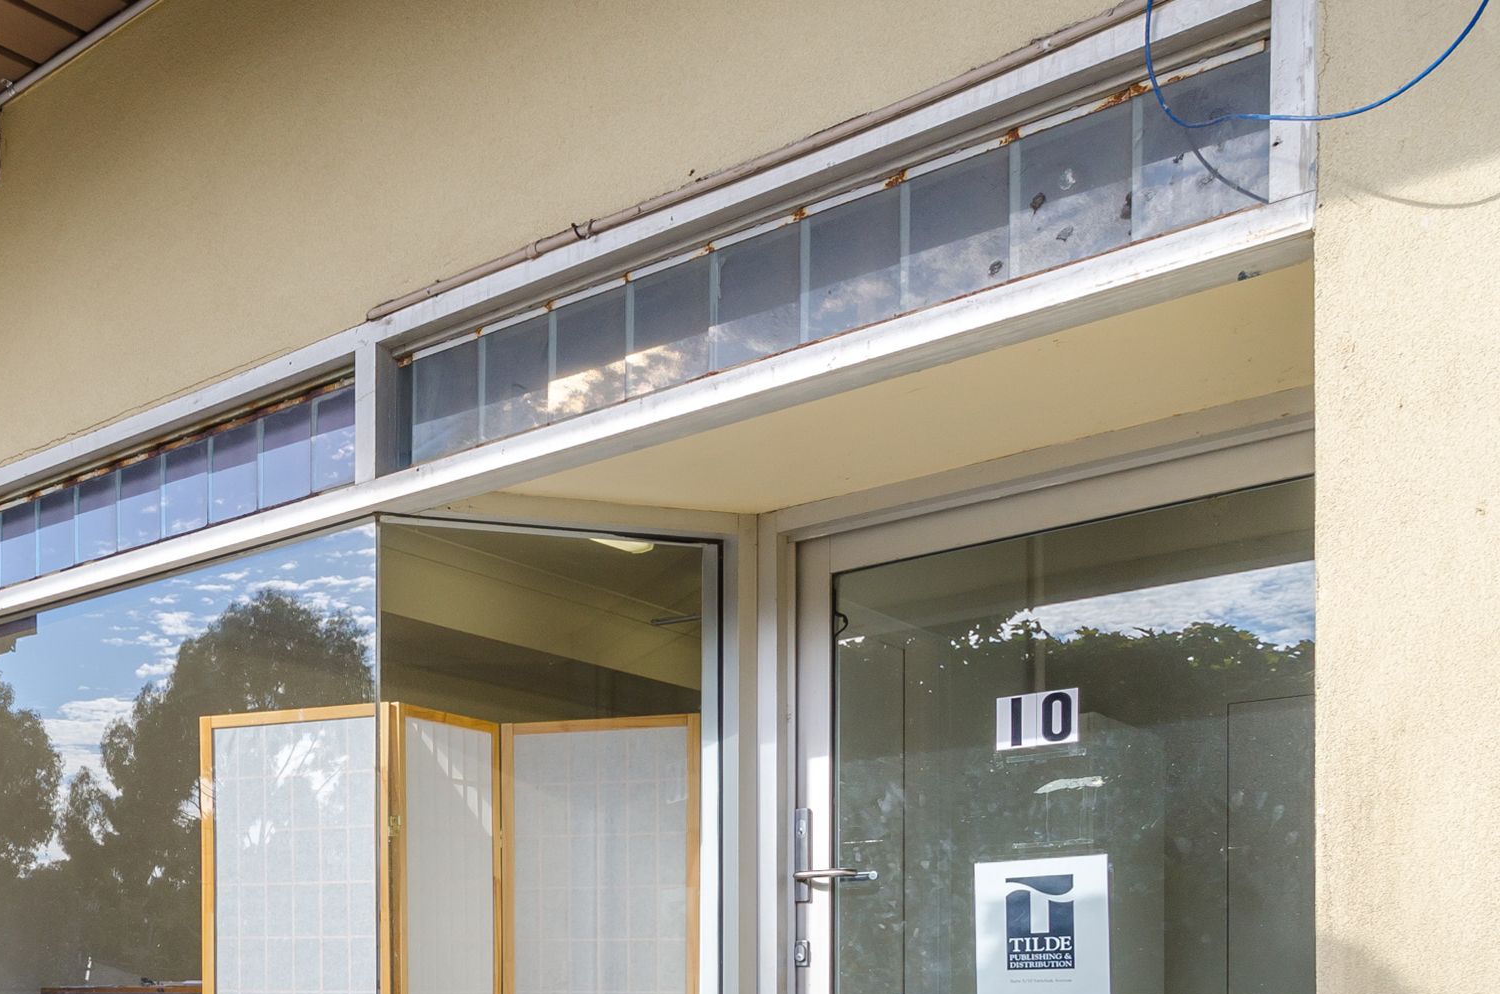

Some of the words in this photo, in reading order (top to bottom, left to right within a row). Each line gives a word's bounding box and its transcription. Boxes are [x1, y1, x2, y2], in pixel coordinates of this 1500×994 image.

[1010, 691, 1073, 747] 10
[1008, 935, 1073, 952] TILDE
[1009, 952, 1062, 961] PUBLISHING
[1064, 952, 1073, 960] &
[1009, 960, 1073, 969] DISTRIBUTION
